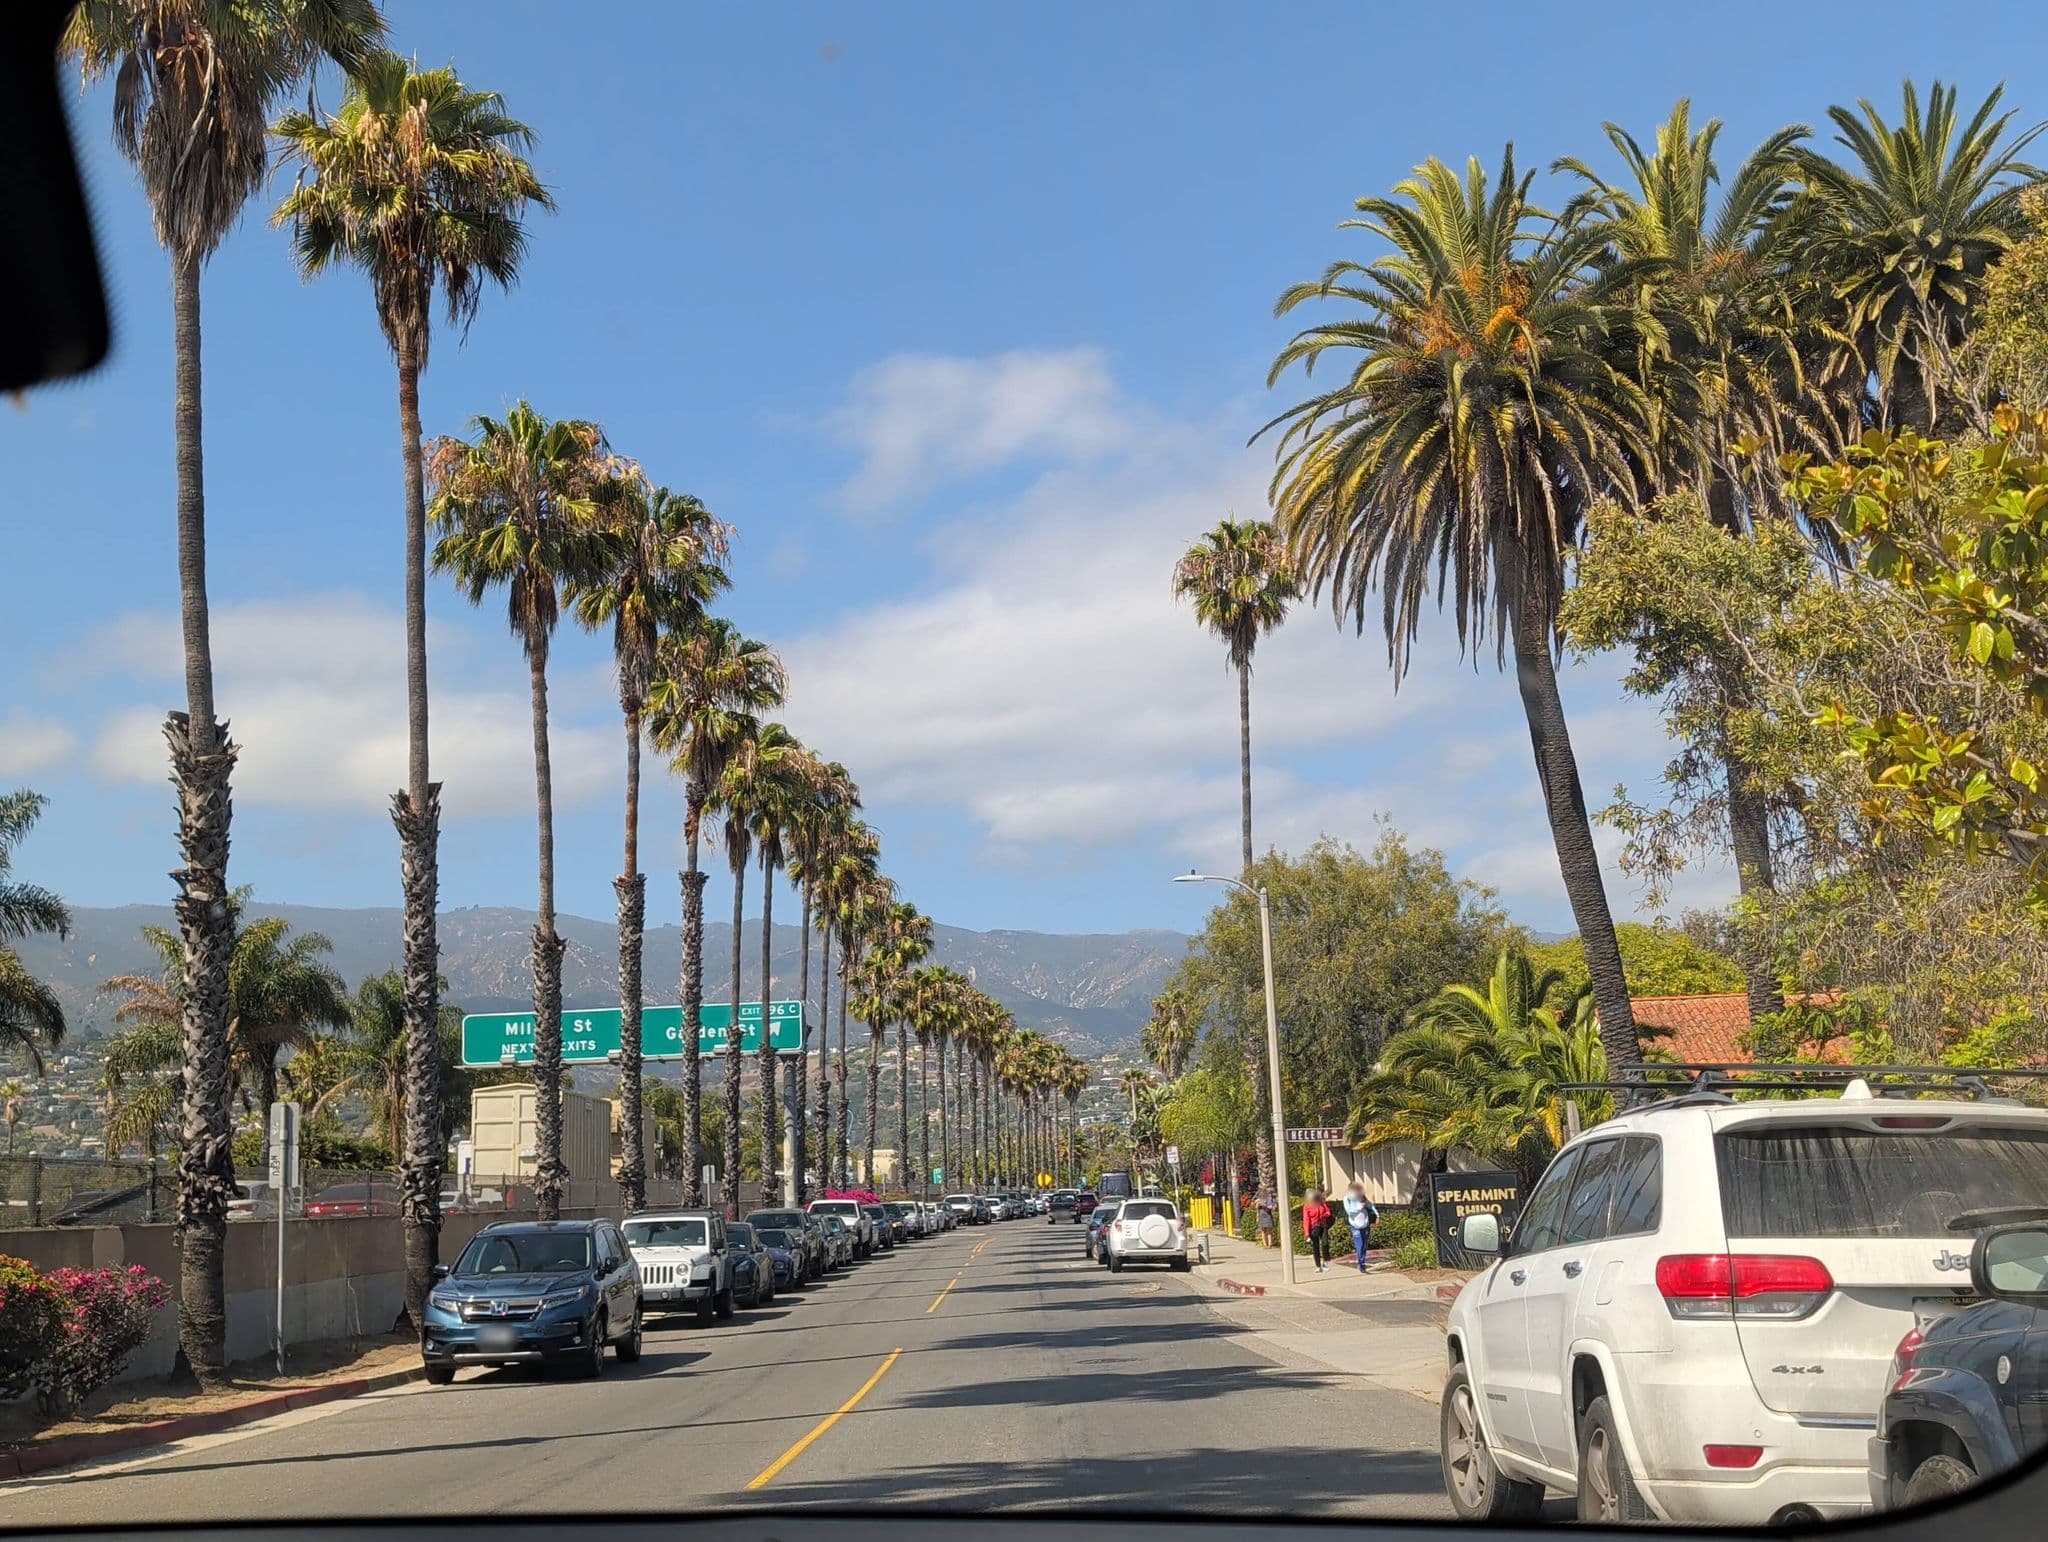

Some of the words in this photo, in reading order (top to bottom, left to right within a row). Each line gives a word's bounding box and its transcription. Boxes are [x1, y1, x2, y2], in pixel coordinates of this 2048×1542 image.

[741, 1007, 760, 1016] EXIT
[788, 1004, 797, 1014] C
[573, 1019, 592, 1032] St
[665, 1025, 728, 1040] Gaden
[501, 1042, 536, 1054] NEXT
[1437, 1187, 1517, 1203] SPEARMINT
[1456, 1203, 1503, 1218] RHINO
[1932, 1249, 1973, 1272] Je
